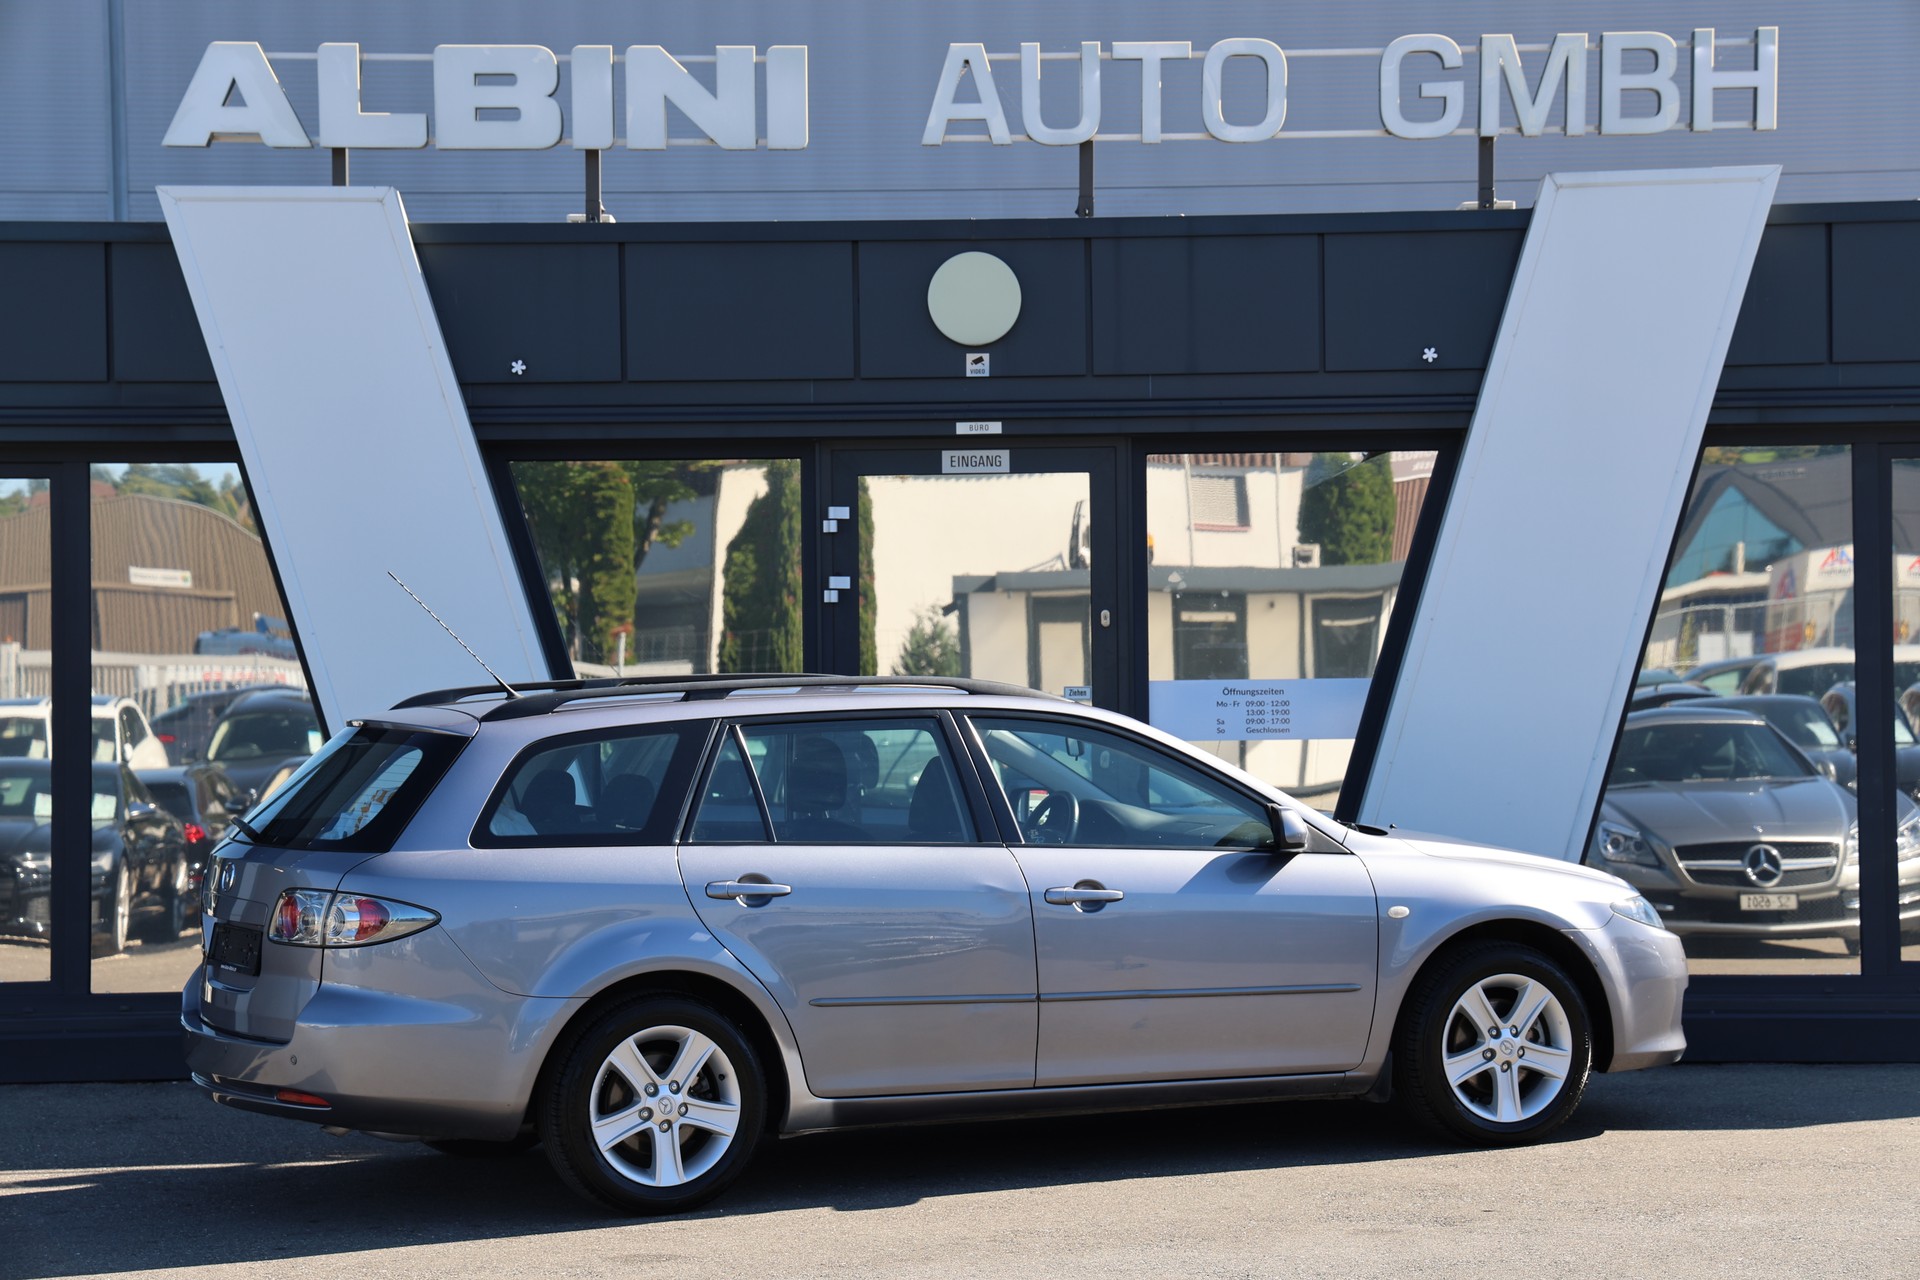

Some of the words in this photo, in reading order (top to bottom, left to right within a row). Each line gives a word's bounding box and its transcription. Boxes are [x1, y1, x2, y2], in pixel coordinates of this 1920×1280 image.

[161, 41, 809, 151] ALBINI
[921, 37, 1288, 146] AUTO
[1379, 26, 1779, 139] GMBH
[969, 423, 990, 432] BÜRO
[950, 454, 1002, 468] EINGANG
[1068, 689, 1087, 697] Ziehen
[1222, 686, 1285, 697] Öffnungszeiten
[1245, 726, 1290, 734] Geschlossen
